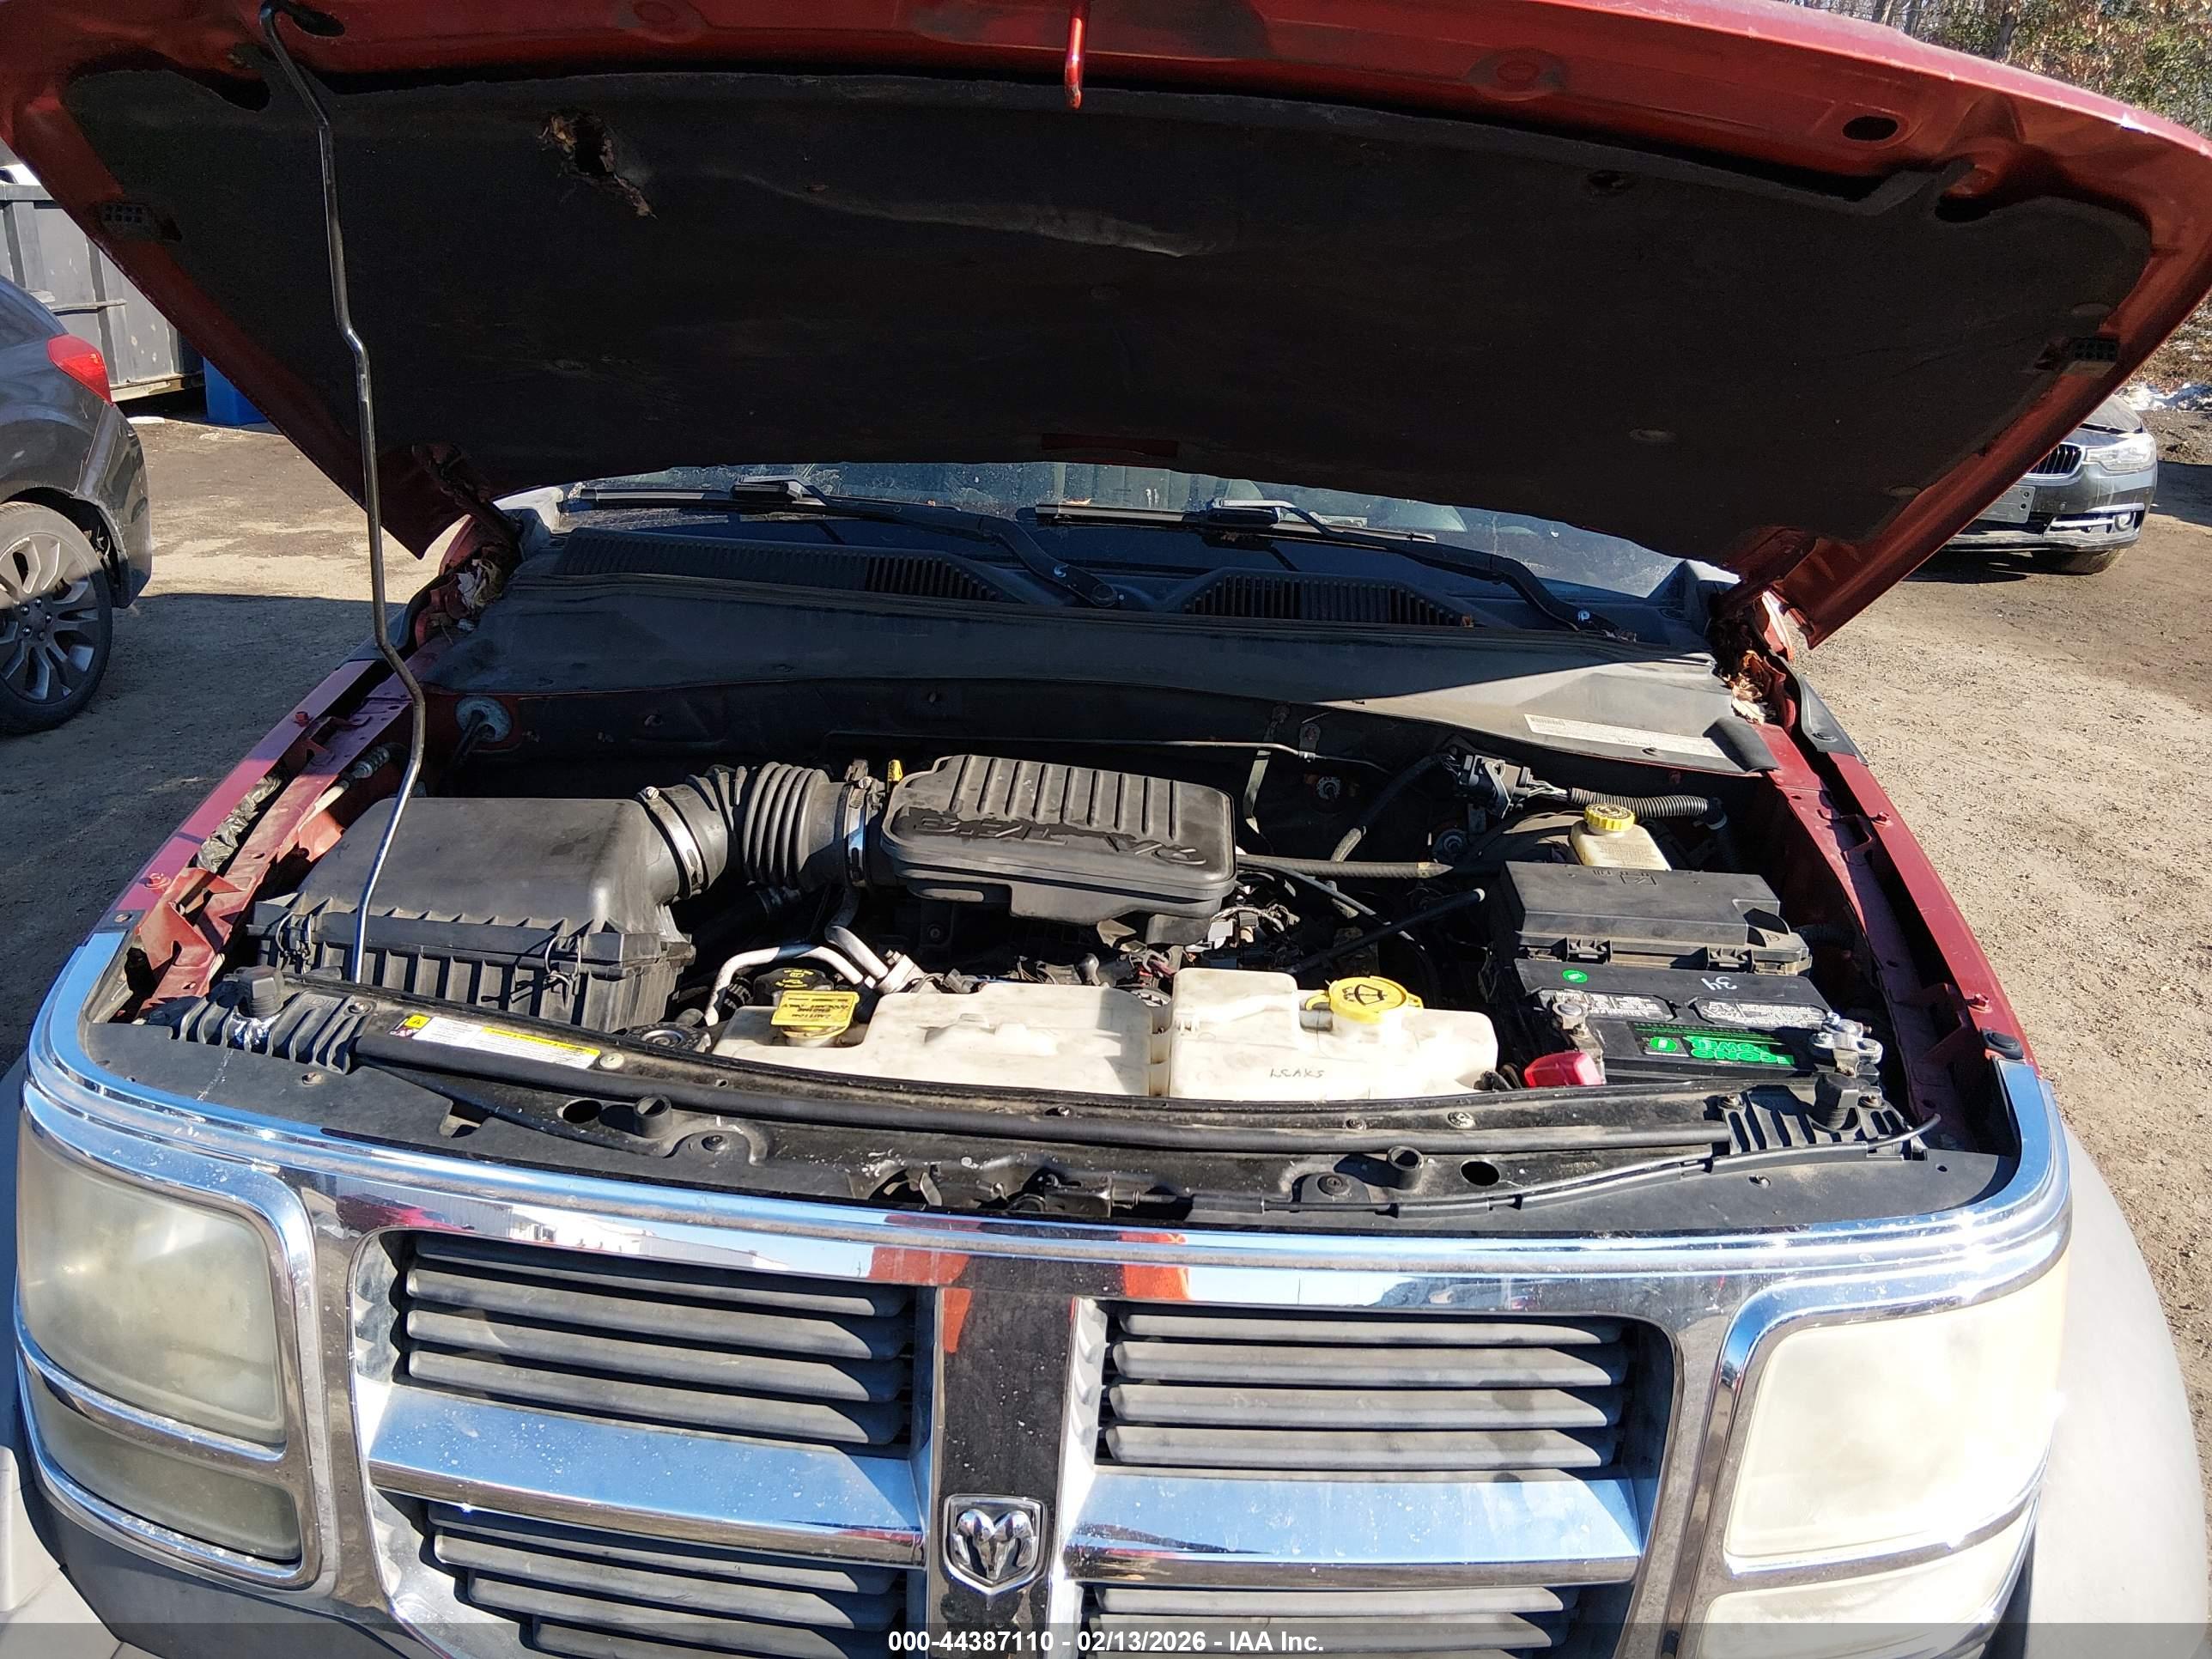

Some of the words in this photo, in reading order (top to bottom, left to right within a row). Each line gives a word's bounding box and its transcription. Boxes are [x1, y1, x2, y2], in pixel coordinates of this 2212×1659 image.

[1104, 835, 1206, 866] V6
[1700, 975, 1738, 991] 34
[1690, 1048, 1795, 1065] ECONO
[1269, 1067, 1325, 1079] LEAKS
